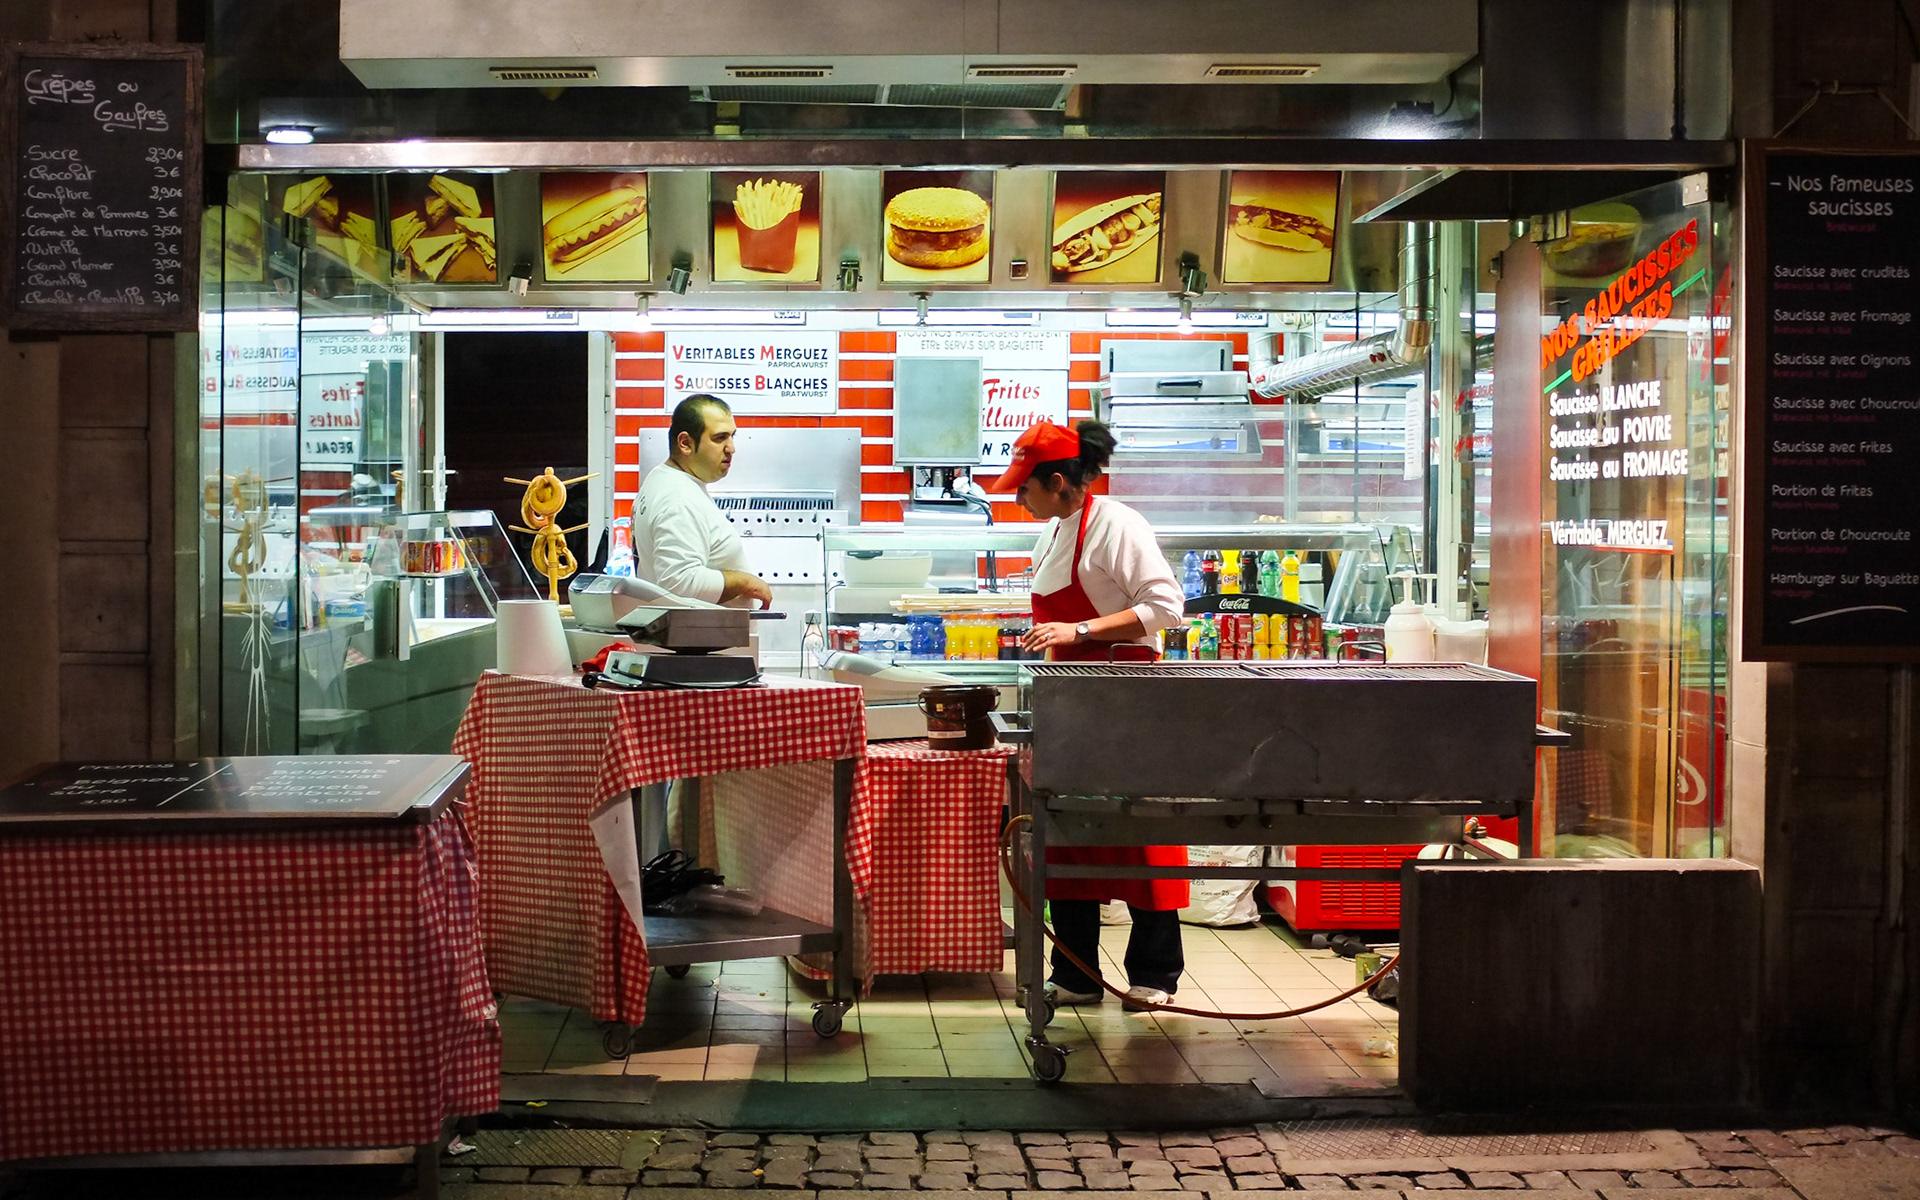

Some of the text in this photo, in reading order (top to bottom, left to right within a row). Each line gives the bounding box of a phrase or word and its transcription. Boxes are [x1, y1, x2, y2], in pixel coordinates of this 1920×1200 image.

[24, 70, 138, 102] Crêpes ou
[94, 100, 168, 130] Gaufres
[28, 145, 82, 160] Sucre
[29, 164, 96, 180] Chocolat
[1788, 174, 1914, 193] Nos fameuses
[28, 186, 92, 204] Confiture
[26, 206, 76, 222] Compote
[82, 208, 95, 218] de
[97, 205, 149, 218] Pommes
[1808, 199, 1894, 216] saucisses
[28, 225, 67, 237] Crème
[72, 225, 89, 237] de
[94, 224, 149, 237] Marrons
[26, 239, 82, 255] Nutella
[27, 258, 66, 271] Grand
[1774, 265, 1910, 278] Saucisse avec crudités
[28, 272, 88, 288] Chantilly
[26, 290, 74, 304] Chocolat
[87, 287, 144, 306] Chantilly
[1541, 217, 1698, 370] NOS SAUCISSES
[1774, 309, 1912, 325] Saucisse avec Fromage
[1572, 281, 1672, 382] GRILLEES
[672, 345, 828, 360] VERITABLES MERGUEZ
[921, 340, 1044, 350] ETRE SERVS SUR BAGUETTE
[1774, 352, 1912, 368] Saucisse avec Oignons
[674, 375, 828, 391] SAUCISSES BLANCHES
[982, 378, 1040, 404] Frites
[1550, 380, 1661, 417] Saucisse BLANCHE
[1772, 396, 1824, 410] Saucisse
[1829, 399, 1856, 410] avec
[982, 406, 1054, 427] illantes
[1550, 414, 1672, 449] Saucisse au POIVRE
[1772, 441, 1894, 454] Saucisse avec Frites
[1550, 449, 1689, 481] Saucisse au FROMAGE
[1772, 484, 1874, 497] Portion de Frites
[1550, 519, 1668, 546] Véritable MERGUEZ
[1772, 528, 1911, 541] Portion de Choucroute
[1770, 572, 1920, 588] Hamburger sur Baguette
[74, 776, 190, 785] Beignets
